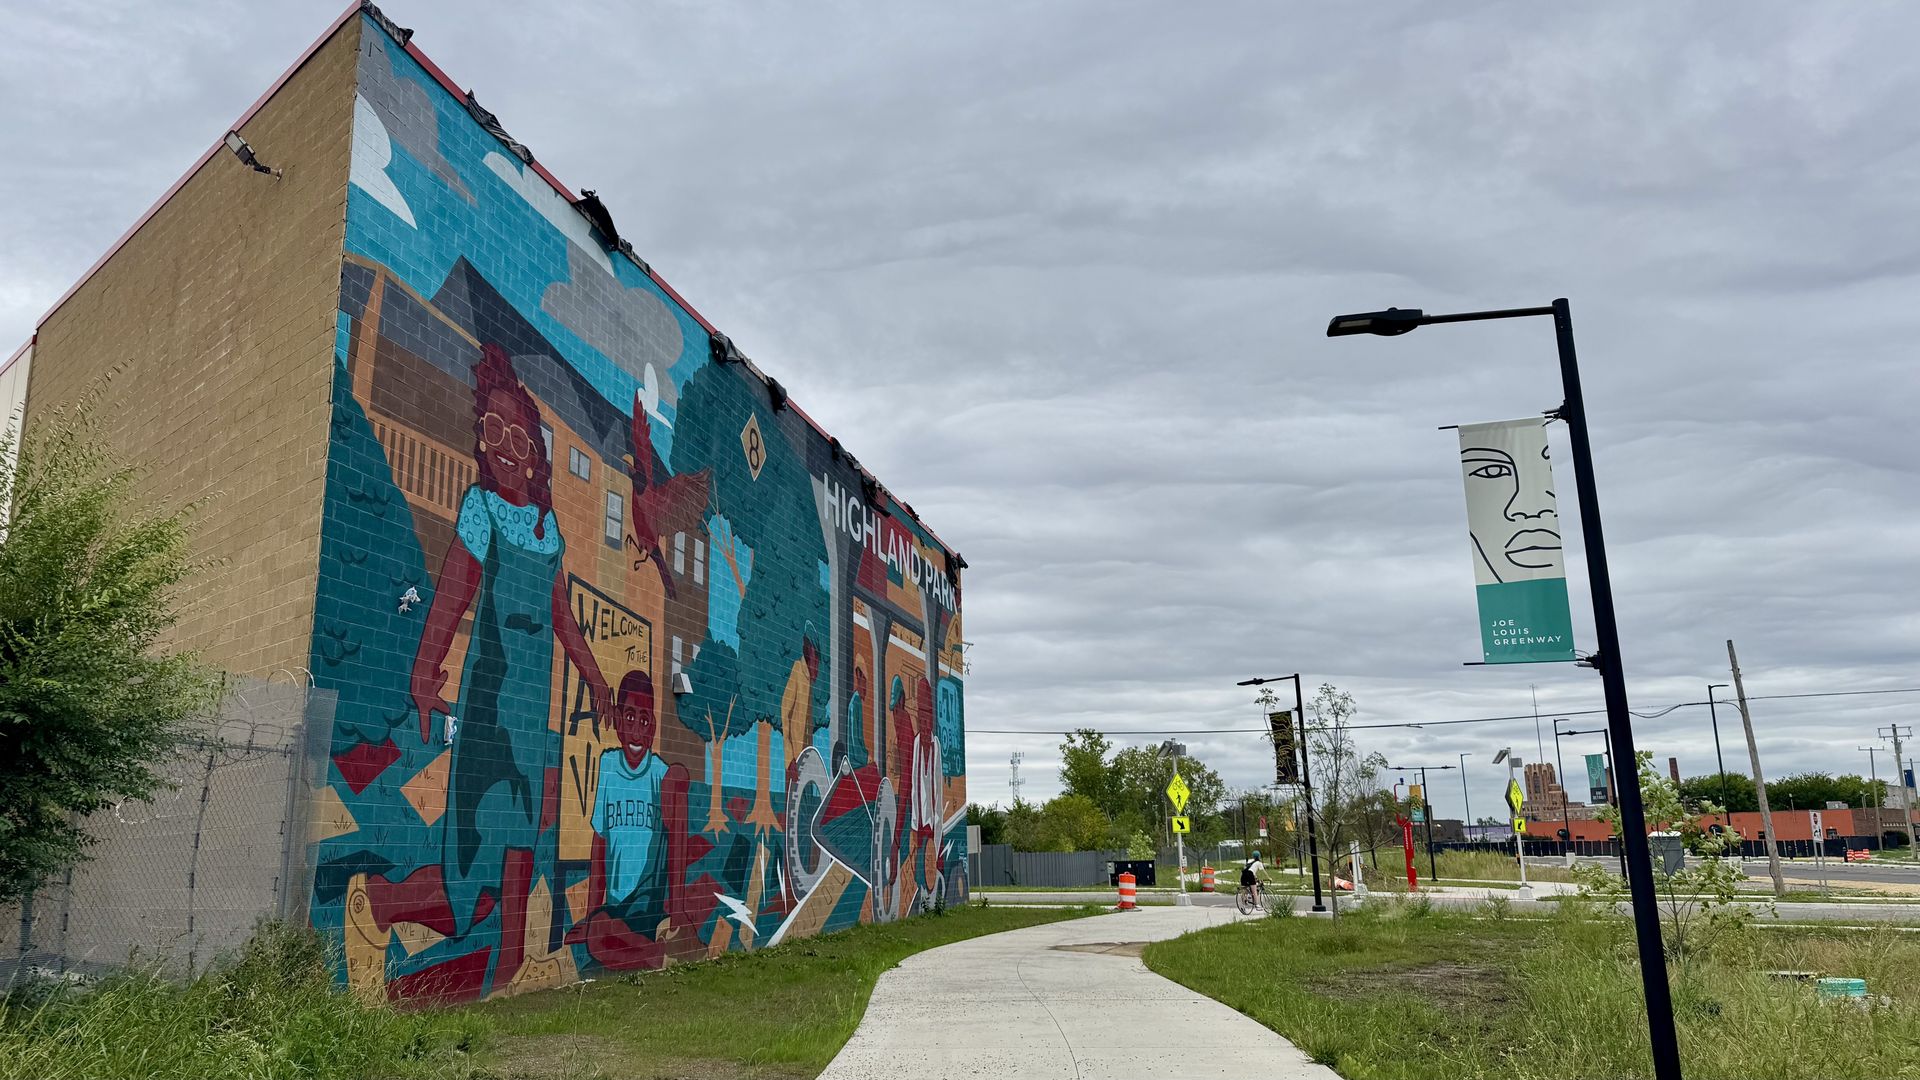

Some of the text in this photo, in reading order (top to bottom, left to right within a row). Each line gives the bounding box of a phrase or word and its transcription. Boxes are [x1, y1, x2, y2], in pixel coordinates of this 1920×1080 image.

[749, 428, 759, 471] 8
[823, 473, 958, 615] HIGHLAND PARK
[578, 594, 644, 643] WELCOME
[1493, 628, 1529, 636] LOUIS
[1494, 636, 1561, 645] GREENWAY
[636, 650, 648, 663] THE
